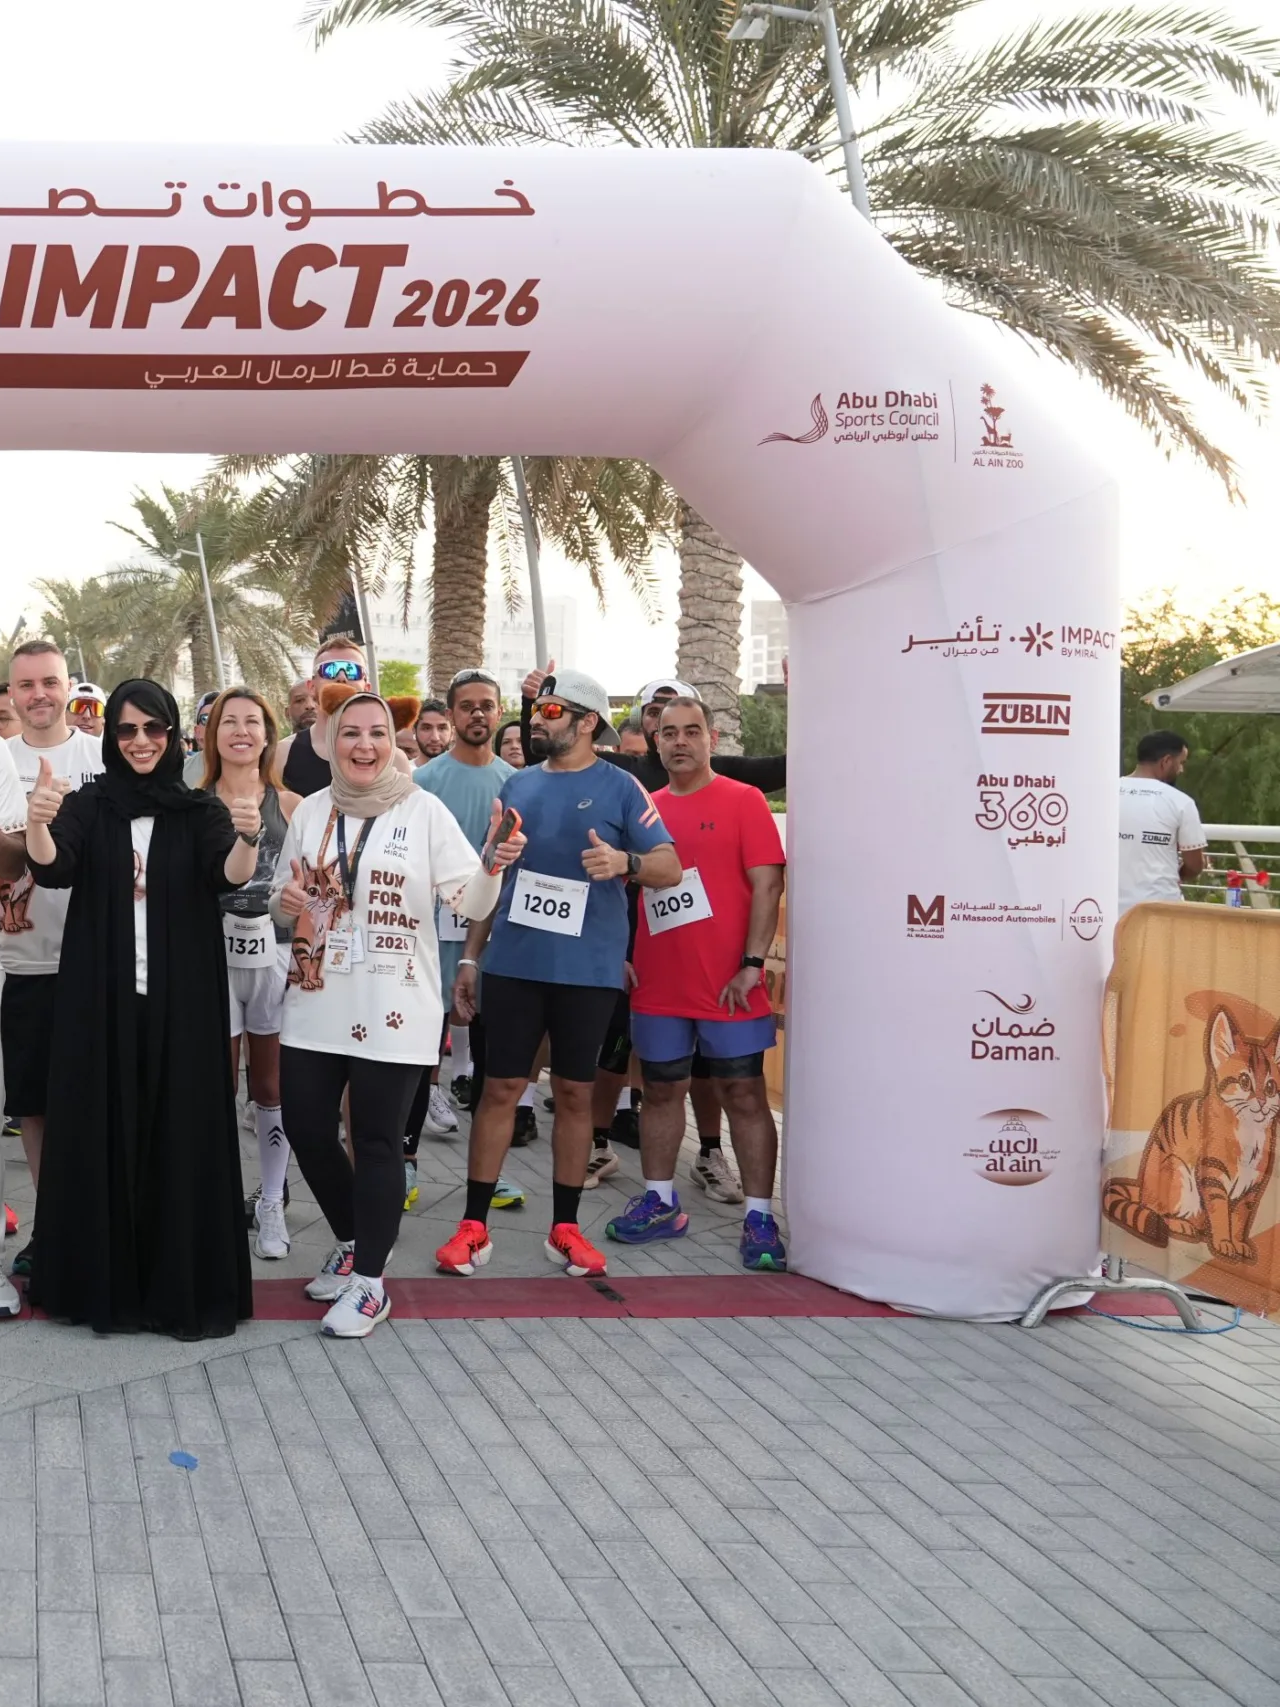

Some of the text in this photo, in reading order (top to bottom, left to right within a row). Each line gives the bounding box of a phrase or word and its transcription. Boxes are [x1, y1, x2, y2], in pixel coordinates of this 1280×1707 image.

[202, 179, 535, 231] خطوات
[392, 278, 541, 328] 2026
[144, 356, 498, 390] حماية قط الرمال العربي
[836, 390, 938, 409] Abu Dhabi
[835, 411, 939, 429] Sports Council
[973, 458, 1024, 469] AL AIN ZOO
[901, 615, 1002, 653] تأثير
[1061, 626, 1116, 650] IMPACT
[1061, 647, 1098, 659] By MIRAL
[976, 774, 1056, 789] Abu Dhabi
[975, 791, 1069, 831] 360
[384, 849, 407, 860] MIRAL
[370, 869, 405, 889] RUN
[368, 890, 402, 907] FOR
[524, 893, 570, 919] 1208
[651, 892, 694, 919] 1209
[950, 914, 1056, 923] Al Masaood Automobiles
[228, 936, 265, 955] 1321
[972, 1017, 1055, 1038] ضمان
[971, 1040, 1054, 1061] Daman
[989, 1137, 1038, 1157] العين
[985, 1156, 1043, 1172] al ain
